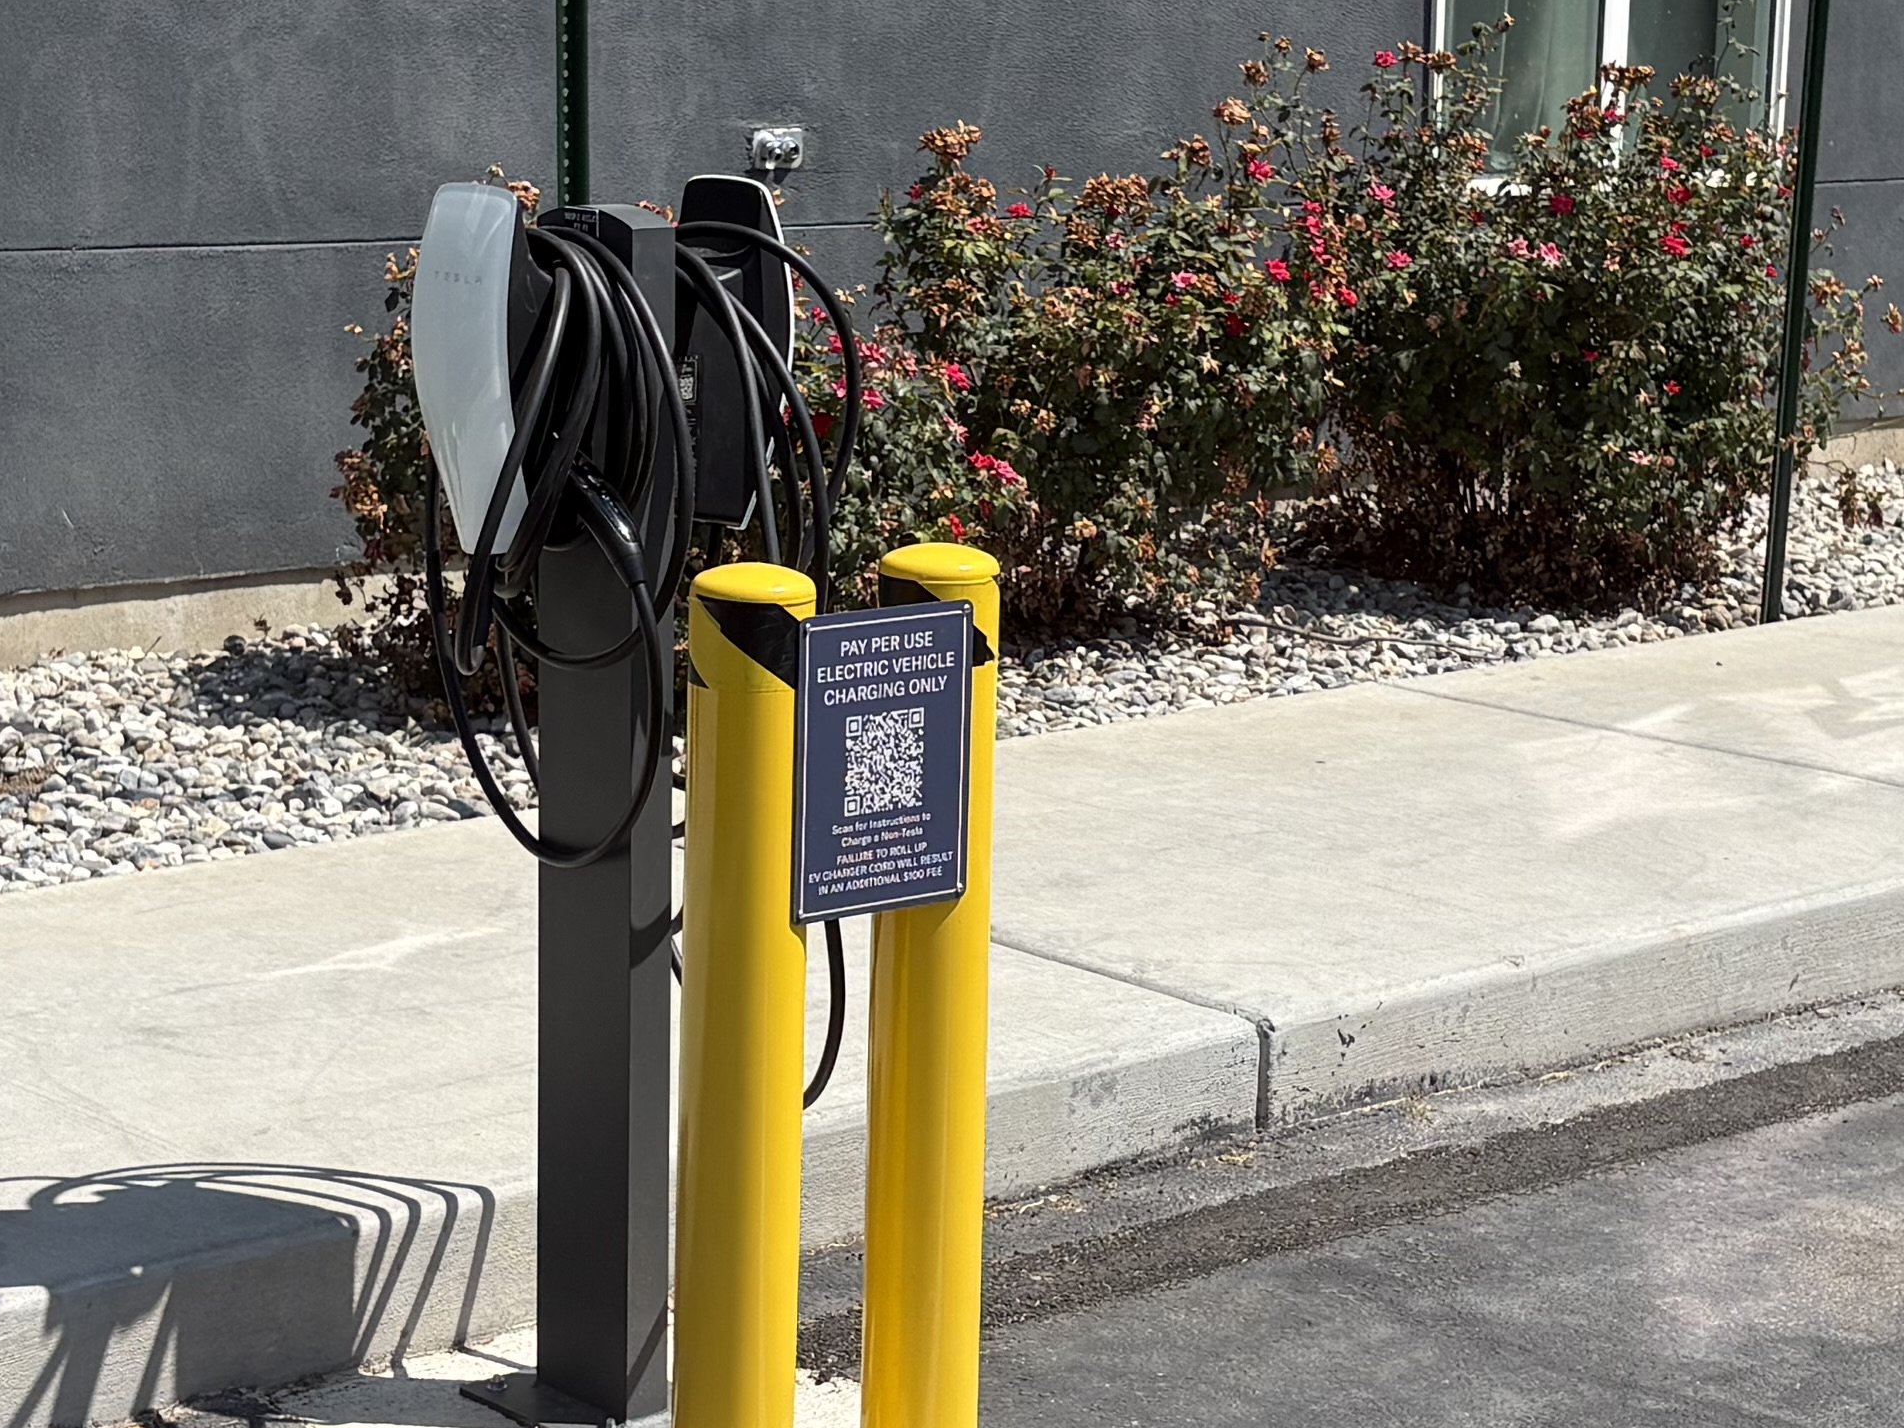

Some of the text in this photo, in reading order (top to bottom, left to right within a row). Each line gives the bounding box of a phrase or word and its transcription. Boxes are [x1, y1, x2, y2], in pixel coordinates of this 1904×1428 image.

[840, 630, 934, 658] PAY PER USE
[816, 651, 955, 684] ELECTRIC VEHICLE
[823, 674, 948, 706] CHARGING ONLY
[831, 824, 854, 835] Scan
[854, 820, 868, 832] for
[921, 812, 932, 821] to
[841, 835, 872, 847] Charge
[881, 826, 924, 841] Non-Tesla
[808, 850, 954, 884] EV CHARGER CORD WILL RESULT
[836, 841, 928, 865] FAILURE TO ROLL UP
[818, 884, 829, 896] IN
[830, 882, 845, 894] AN
[845, 872, 901, 891] ADDITIONAL
[926, 865, 943, 878] FEE
